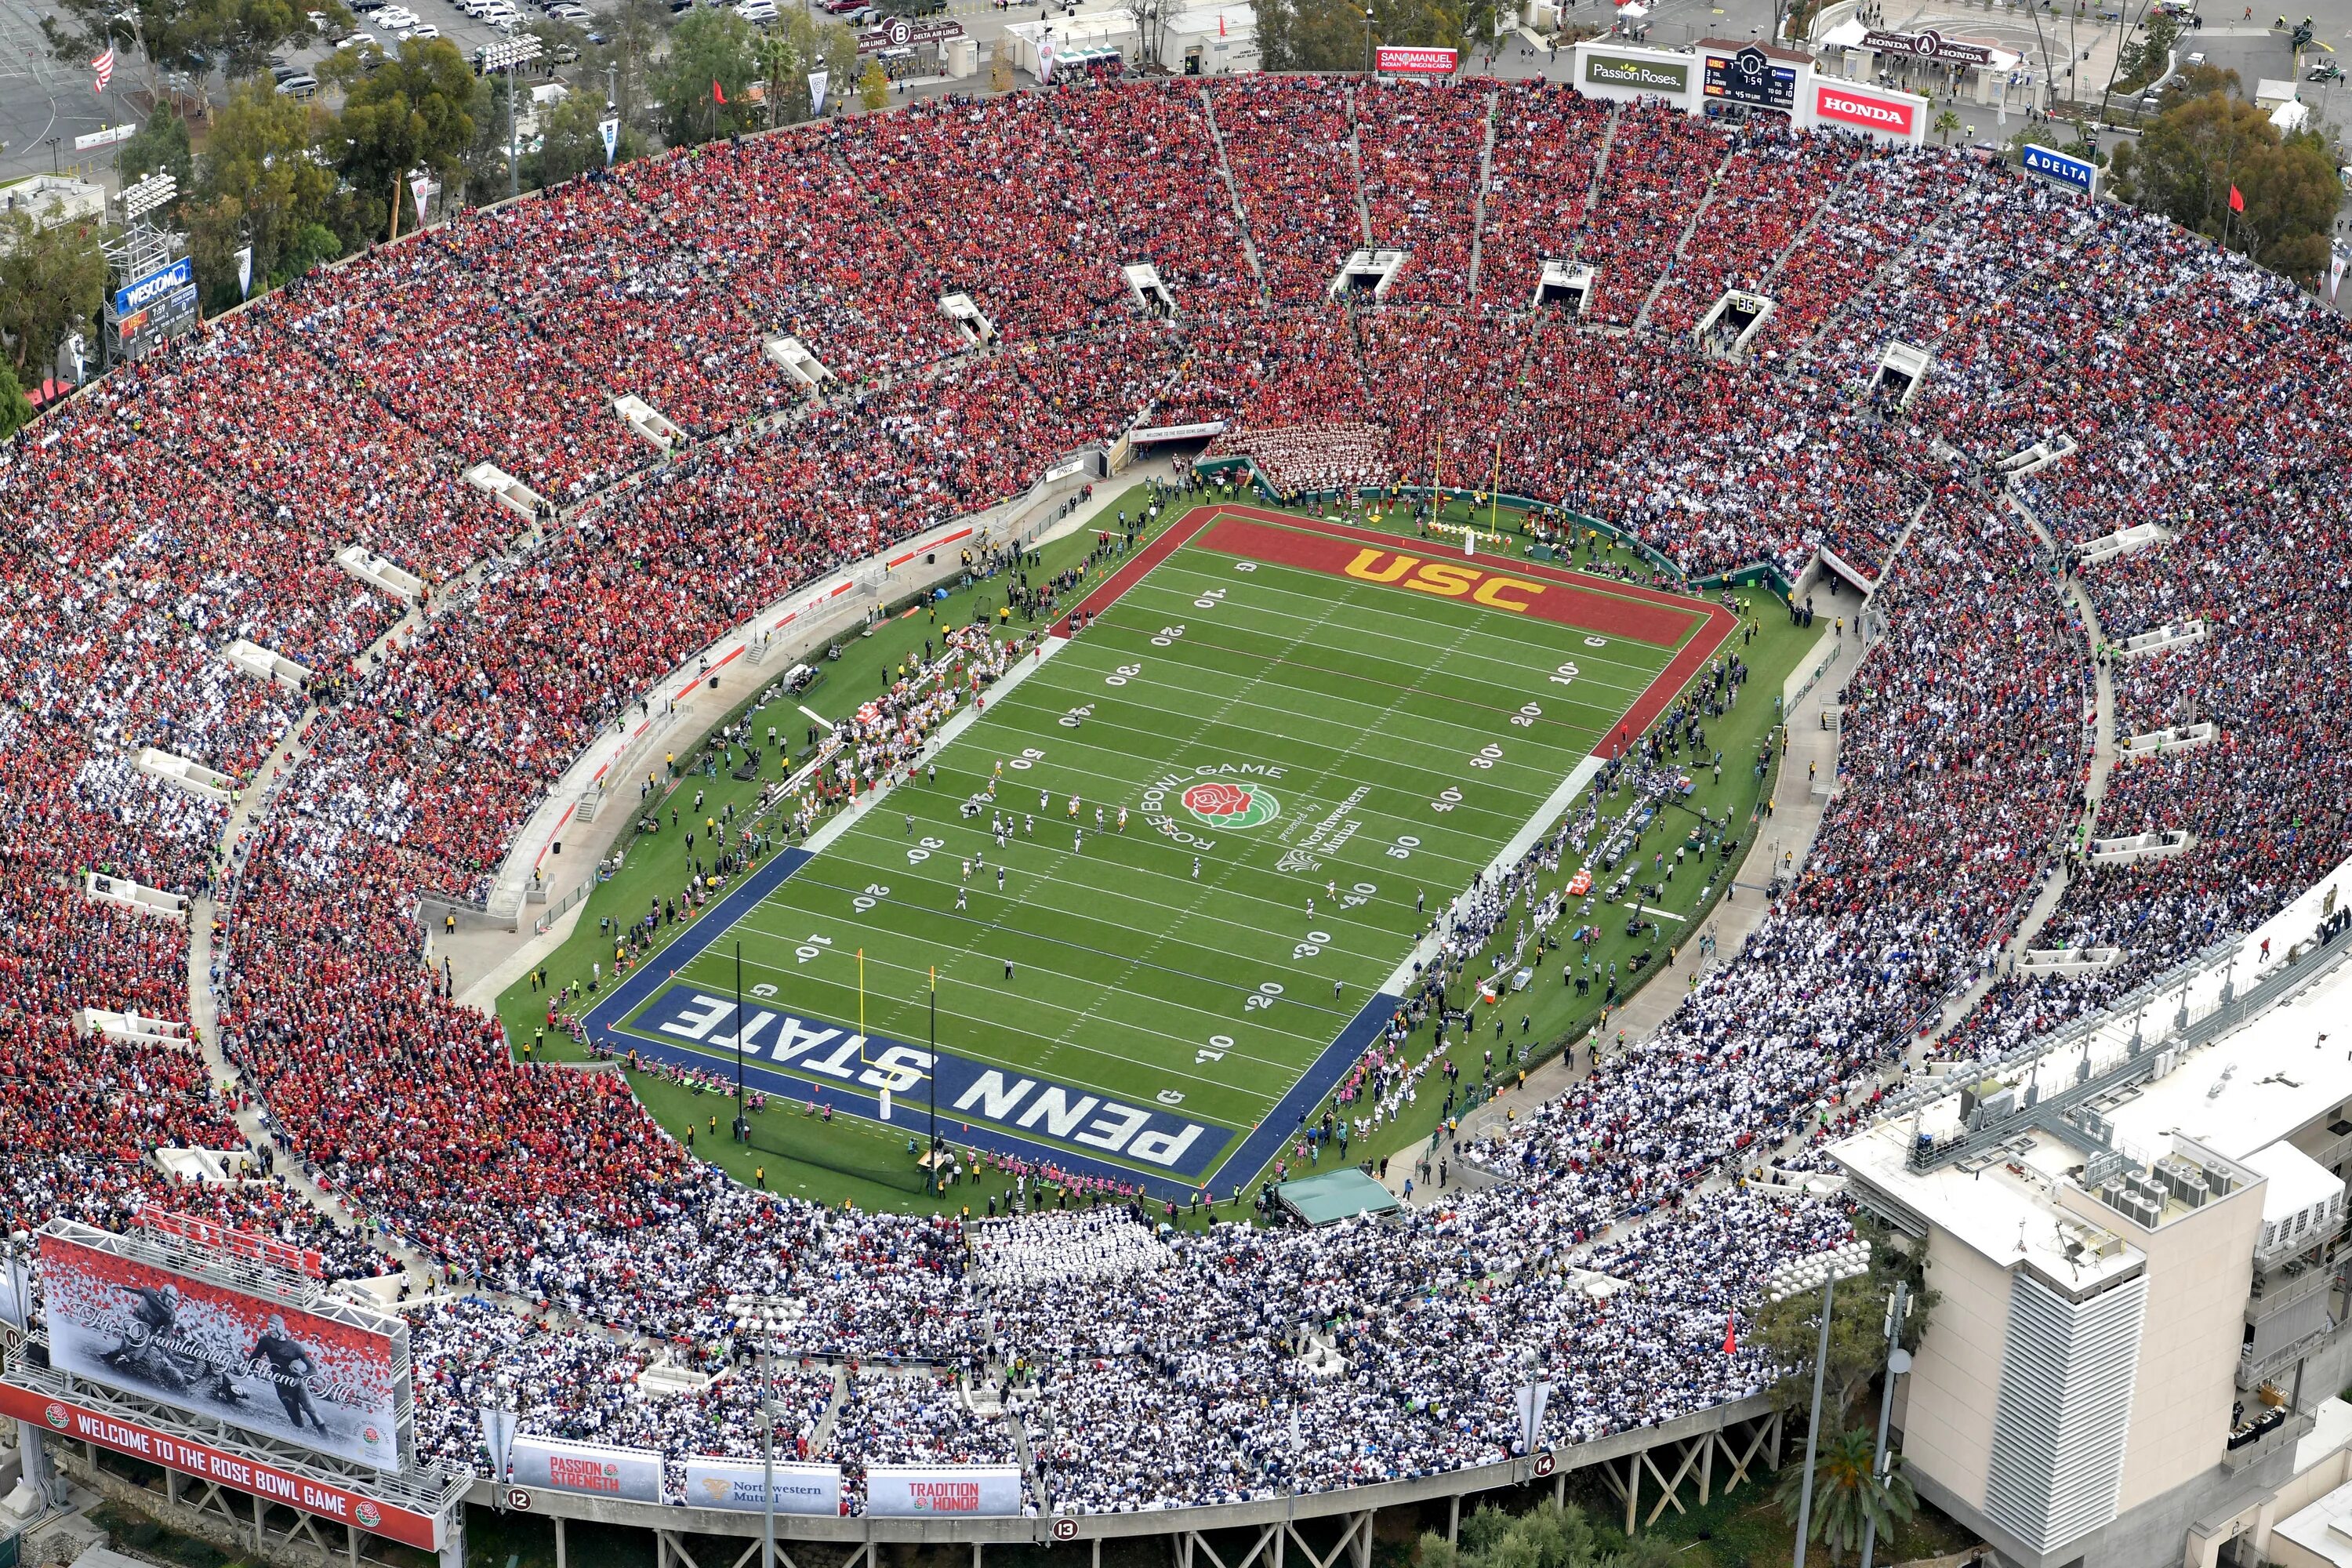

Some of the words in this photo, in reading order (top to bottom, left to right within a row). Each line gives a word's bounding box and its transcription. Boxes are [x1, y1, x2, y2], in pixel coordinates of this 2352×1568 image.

[895, 27, 906, 42] B
[1867, 38, 1911, 50] HONDA
[1920, 38, 1930, 52] A
[1381, 53, 1401, 61] SAN
[1411, 53, 1452, 63] MANUEL
[1709, 59, 1724, 69] USC
[1938, 49, 1984, 61] HONDA
[1594, 64, 1639, 80] Passion
[1641, 69, 1676, 85] Roses
[1744, 75, 1762, 85] 7:59
[1824, 97, 1904, 125] HONDA
[2042, 157, 2087, 182] DELTA
[127, 271, 174, 307] WESCOM
[153, 304, 165, 317] 7:59
[182, 302, 186, 311] 0
[1739, 298, 1753, 312] 36
[129, 315, 142, 326] USC
[134, 327, 138, 336] 7
[1345, 549, 1547, 612] USC
[1193, 590, 1224, 608] 10
[1150, 626, 1183, 646] 20
[1105, 666, 1139, 686] 30
[1549, 665, 1579, 685] 10
[1058, 707, 1091, 728] 40
[1510, 705, 1542, 728] 20
[1010, 748, 1046, 770] 50
[1469, 748, 1503, 769] 30
[1195, 763, 1288, 779] GAME
[1140, 773, 1195, 811] BOWL
[1430, 789, 1463, 812] 40
[960, 793, 993, 815] 40
[1277, 812, 1308, 843] presented
[1306, 802, 1323, 813] by
[1297, 786, 1372, 850] Northwestern
[1145, 815, 1216, 851] ROSE
[1317, 819, 1363, 855] Mutual
[906, 837, 945, 860] 30
[1385, 836, 1421, 859] 50
[852, 883, 890, 909] 20
[1344, 883, 1377, 906] 40
[795, 934, 833, 958] 10
[1294, 931, 1331, 956] 30
[750, 983, 779, 997] G
[1247, 982, 1284, 1009] 20
[659, 994, 939, 1092] STATE
[1197, 1035, 1234, 1062] 10
[1156, 1089, 1185, 1105] G
[952, 1069, 1206, 1167] PENN
[69, 1301, 122, 1331] The
[122, 1318, 232, 1373] Granddaddy
[230, 1357, 262, 1380] of
[258, 1363, 297, 1388] them
[302, 1374, 354, 1403] All
[77, 1414, 151, 1454] WELCOME
[153, 1438, 174, 1461] TO
[177, 1445, 206, 1472] THE
[210, 1455, 251, 1486] ROSE
[255, 1470, 299, 1501] BOWL
[304, 1486, 347, 1516] GAME
[550, 1457, 601, 1475] PASSION
[1538, 1458, 1552, 1472] 14
[551, 1472, 619, 1493] STRENGTH
[909, 1483, 978, 1496] TRADITION
[513, 1493, 527, 1507] 12
[734, 1492, 779, 1504] Mutul
[933, 1497, 978, 1511] HONOR
[1058, 1523, 1073, 1535] 13
